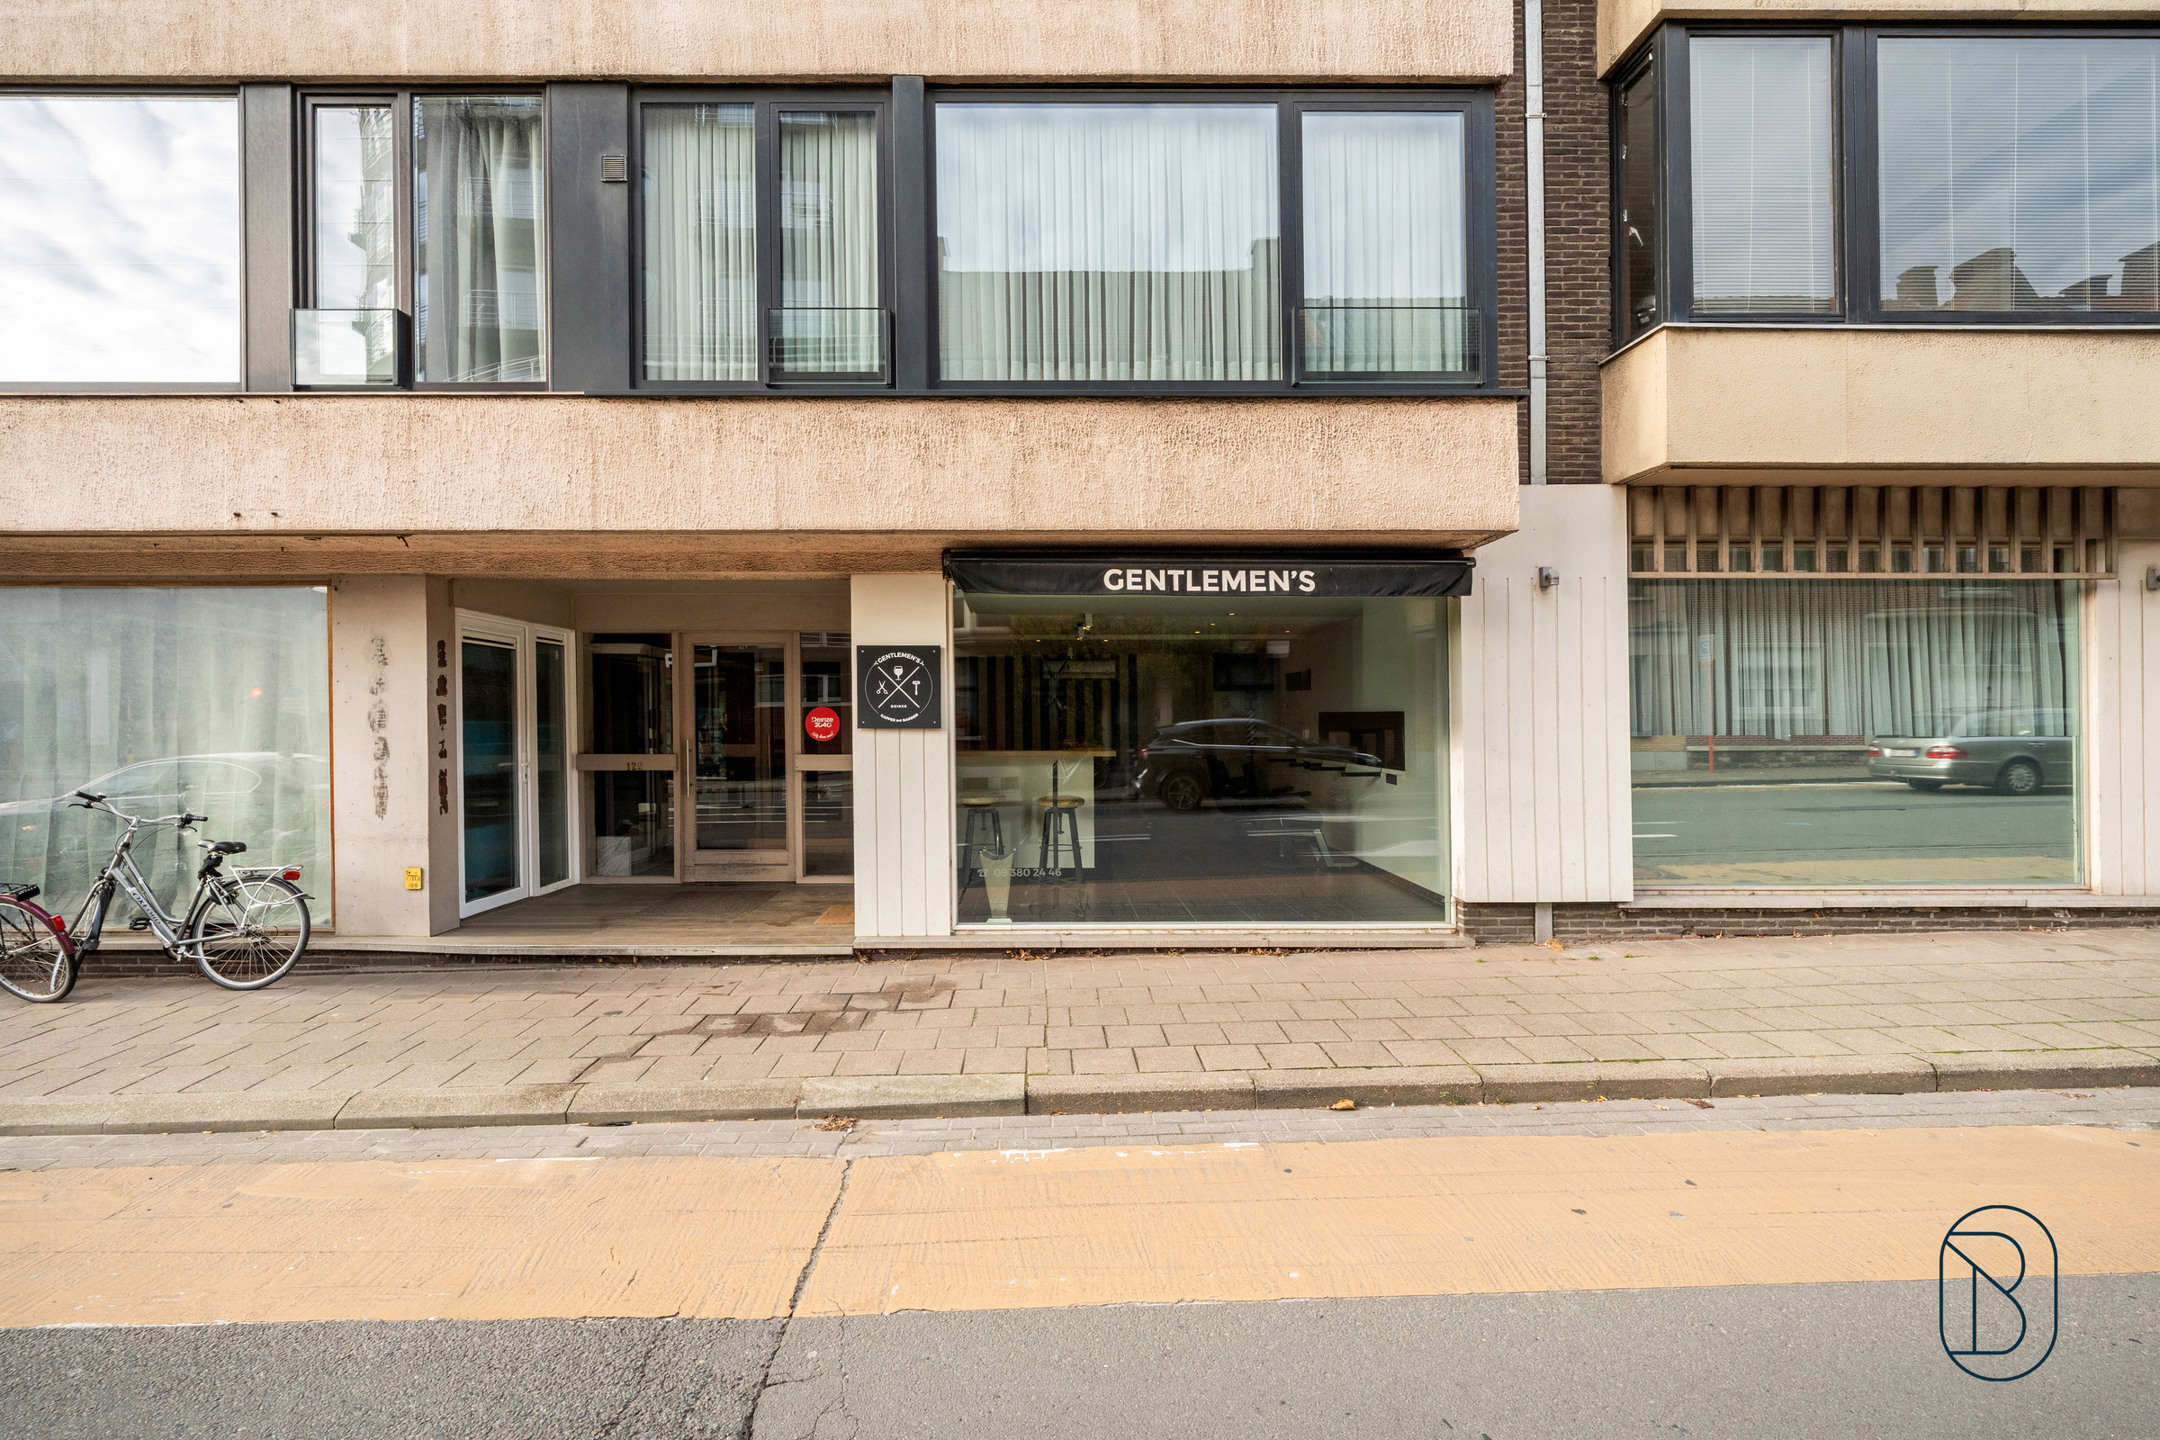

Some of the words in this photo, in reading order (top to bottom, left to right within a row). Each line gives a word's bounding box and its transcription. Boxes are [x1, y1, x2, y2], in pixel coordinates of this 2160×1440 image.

[1103, 568, 1316, 592] GENTLEMEN'S
[877, 652, 921, 664] GENTLEMEN'S
[993, 868, 1008, 877] 09
[1010, 868, 1031, 877] 380
[1033, 868, 1046, 877] 24
[1048, 868, 1062, 877] 46
